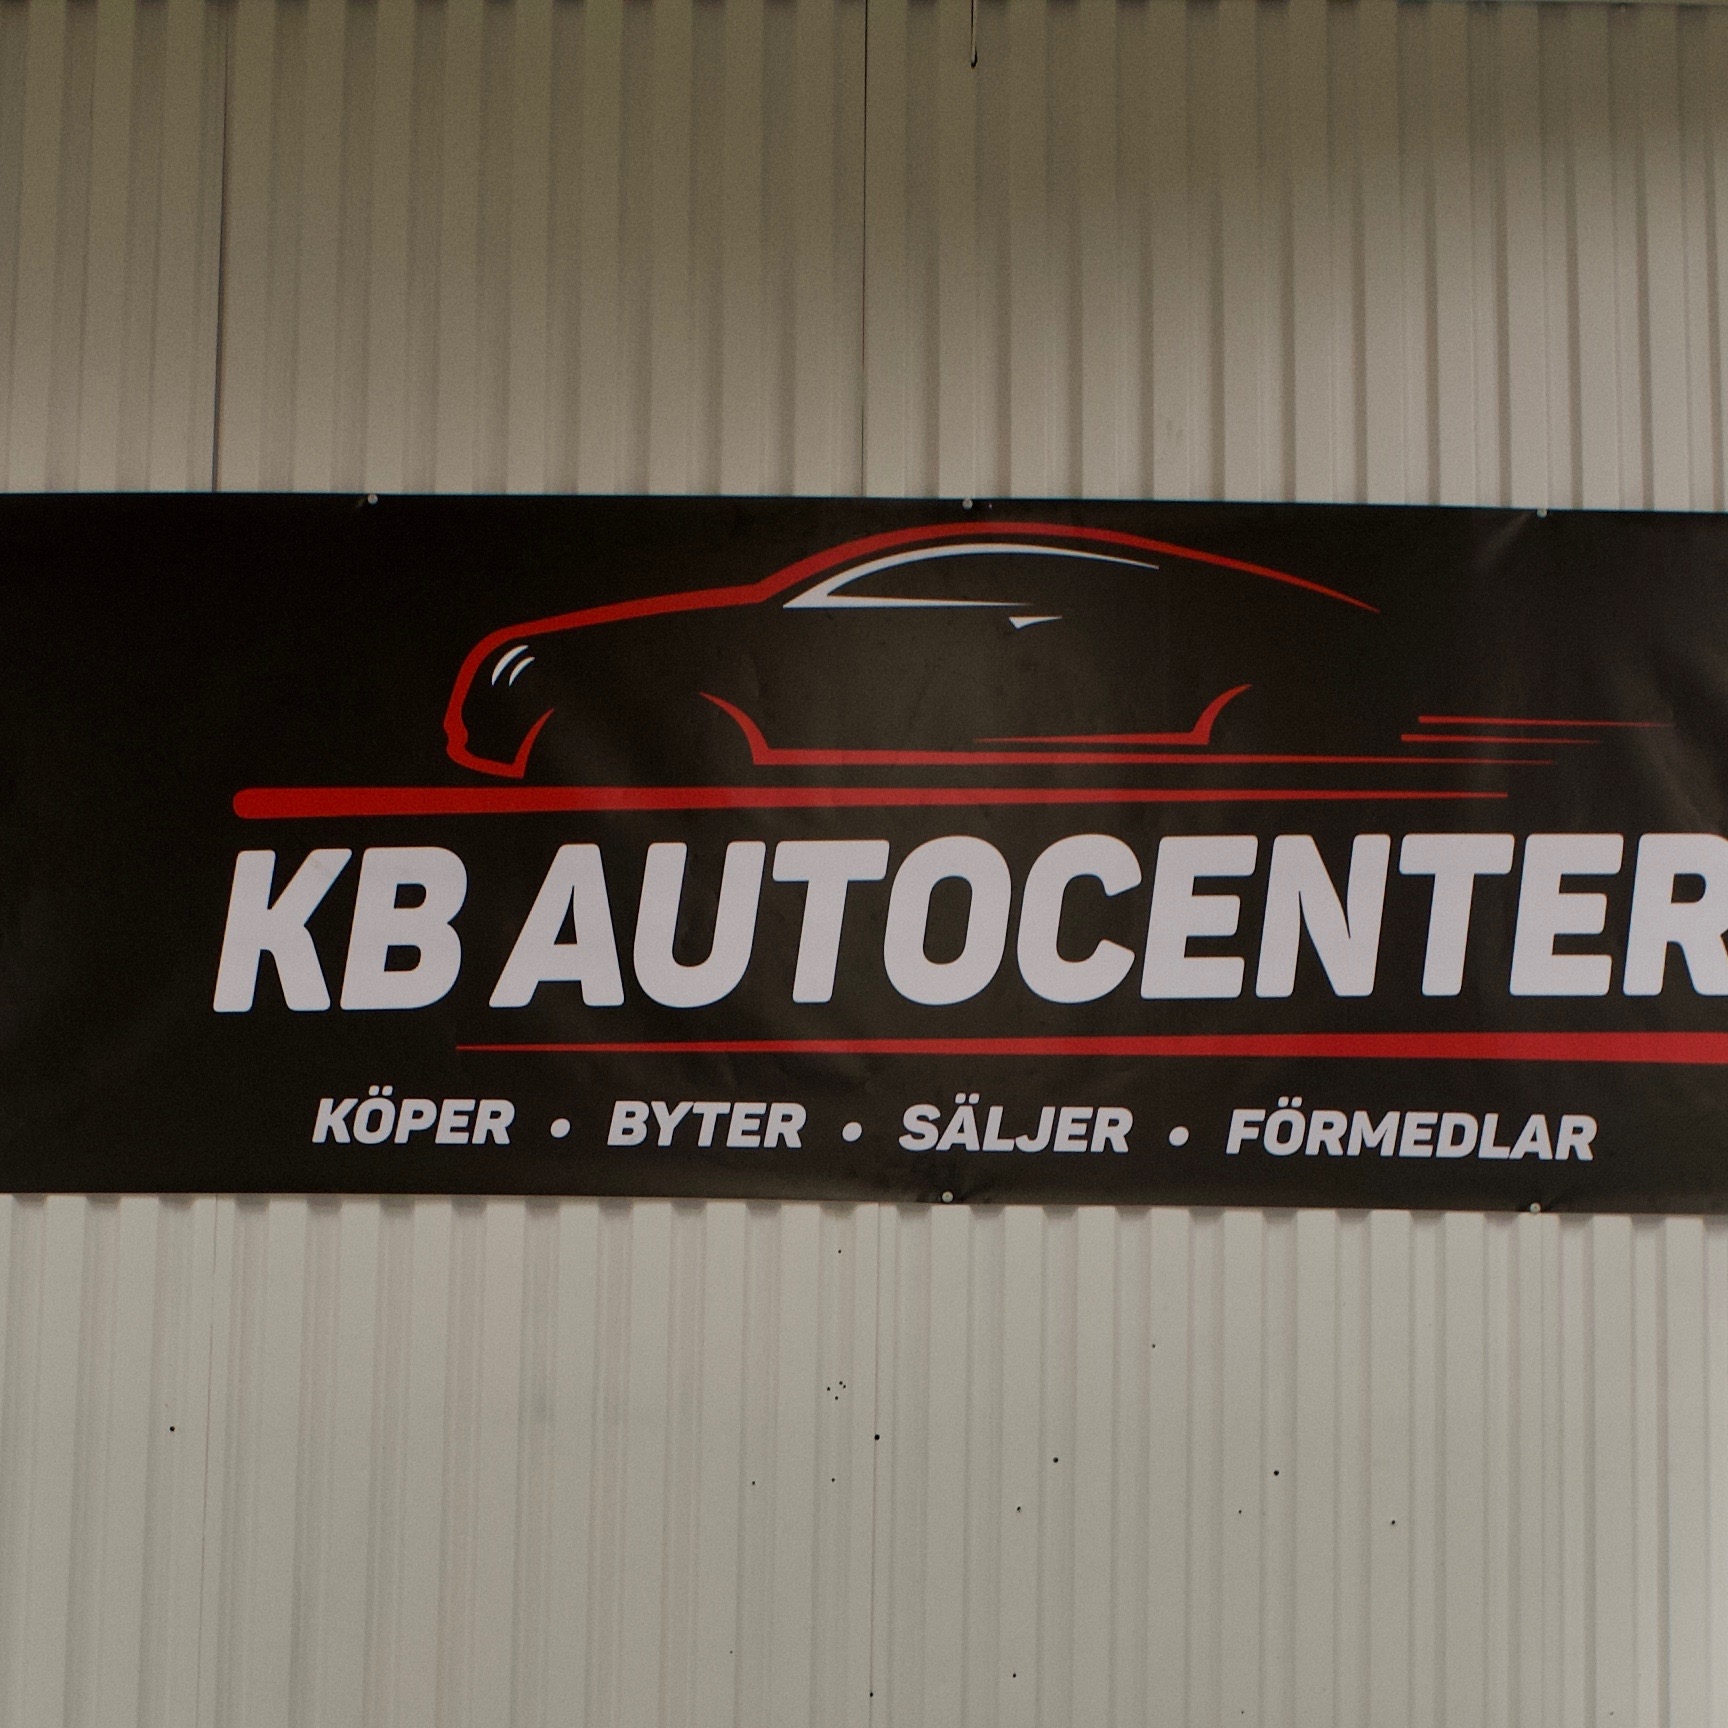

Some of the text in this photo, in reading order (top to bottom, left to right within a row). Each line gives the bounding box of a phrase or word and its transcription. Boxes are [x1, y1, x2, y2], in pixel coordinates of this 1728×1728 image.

[213, 846, 469, 1013] KB
[311, 1085, 1598, 1161] KÖPER BYTER SÄLJER FÖRMEDLAR
